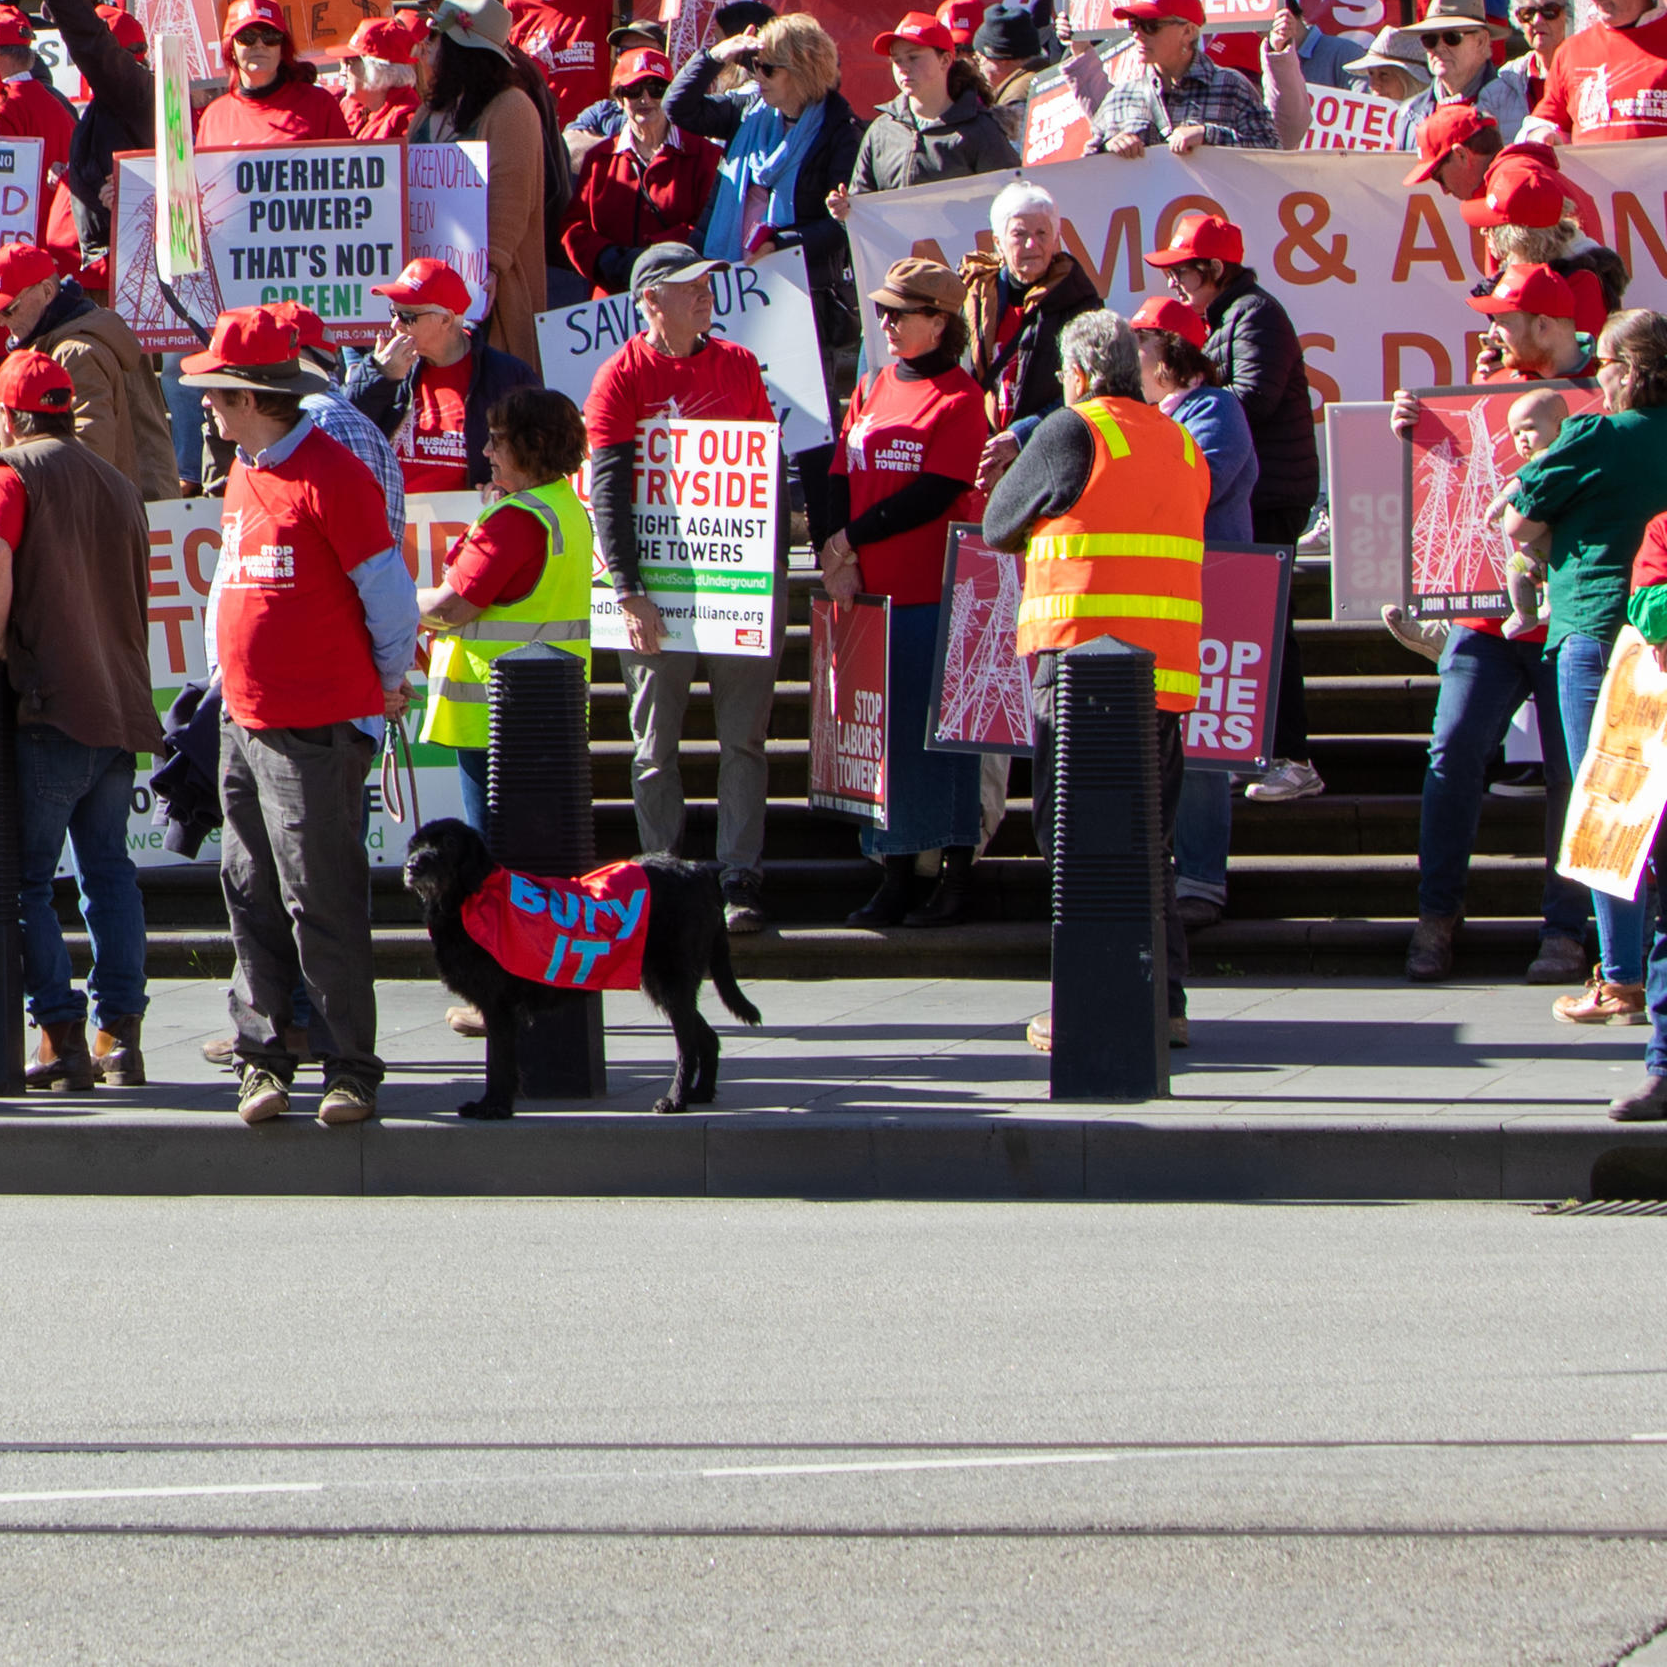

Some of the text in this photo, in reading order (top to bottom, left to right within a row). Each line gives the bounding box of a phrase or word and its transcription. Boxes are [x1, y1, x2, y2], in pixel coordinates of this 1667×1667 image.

[236, 156, 385, 194] OVERHEAD
[249, 196, 373, 233] POWER?
[1272, 191, 1357, 285] &
[229, 244, 327, 281] THAT'S
[336, 243, 394, 277] NOT
[146, 336, 167, 347] THE
[698, 428, 767, 467] OUR
[874, 449, 922, 464] LABOR'S
[891, 438, 924, 453] STOP
[874, 459, 921, 473] TOWERS
[686, 515, 767, 540] AGAINST
[260, 545, 294, 557] STOP
[666, 540, 744, 564] TOWERS
[245, 565, 294, 579] TOWERS
[1421, 593, 1506, 612] JOIN THE FIGHT.
[854, 689, 883, 725] STOP
[837, 723, 882, 760] LABOR'S
[837, 757, 883, 796] TOWERS
[545, 937, 610, 985] IT
